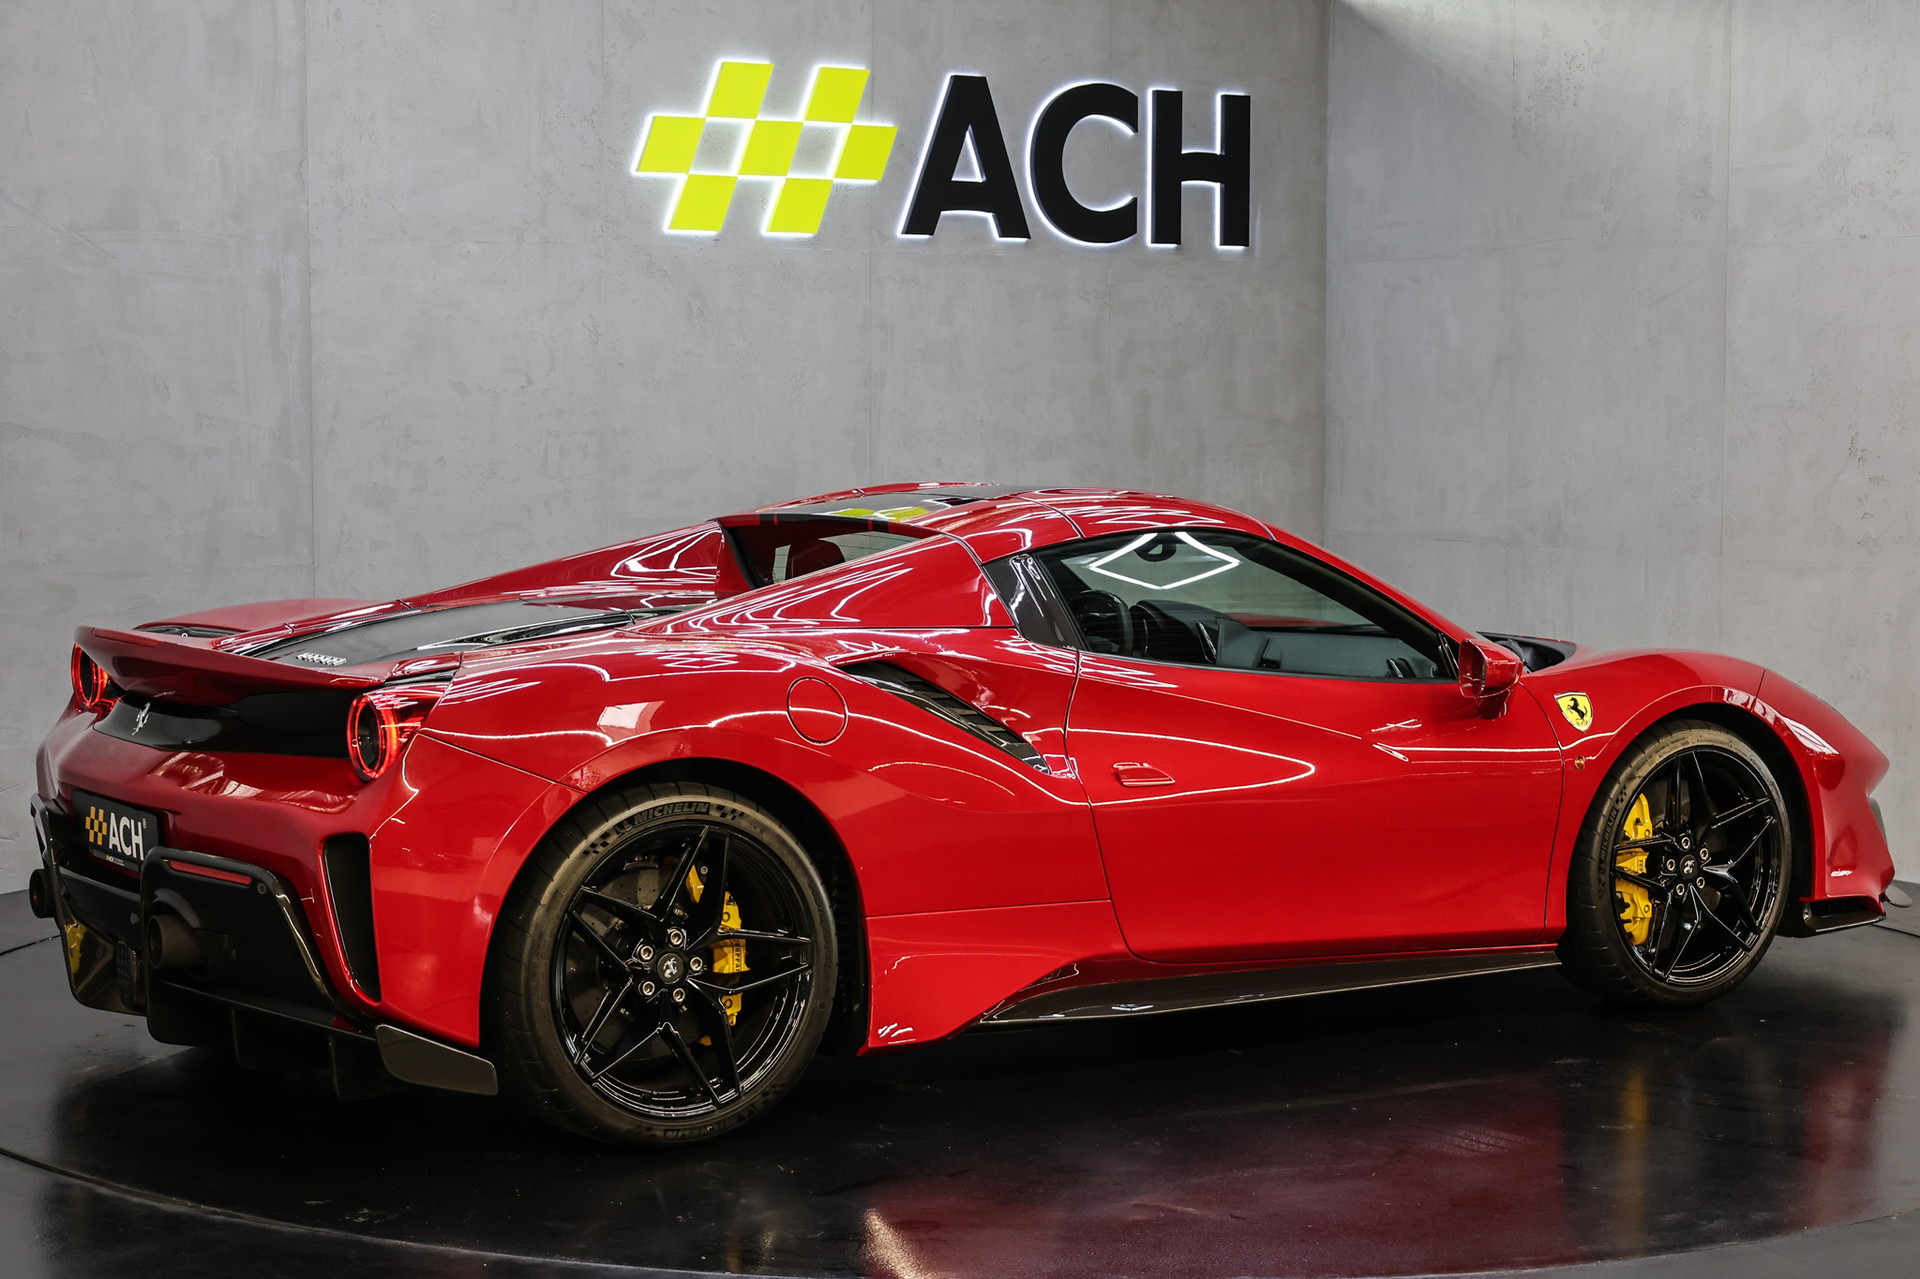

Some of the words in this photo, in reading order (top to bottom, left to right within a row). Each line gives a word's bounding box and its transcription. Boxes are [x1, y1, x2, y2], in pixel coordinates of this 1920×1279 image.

[902, 74, 1251, 248] ACH
[109, 812, 144, 861] ACH
[635, 802, 710, 824] MICHELIN
